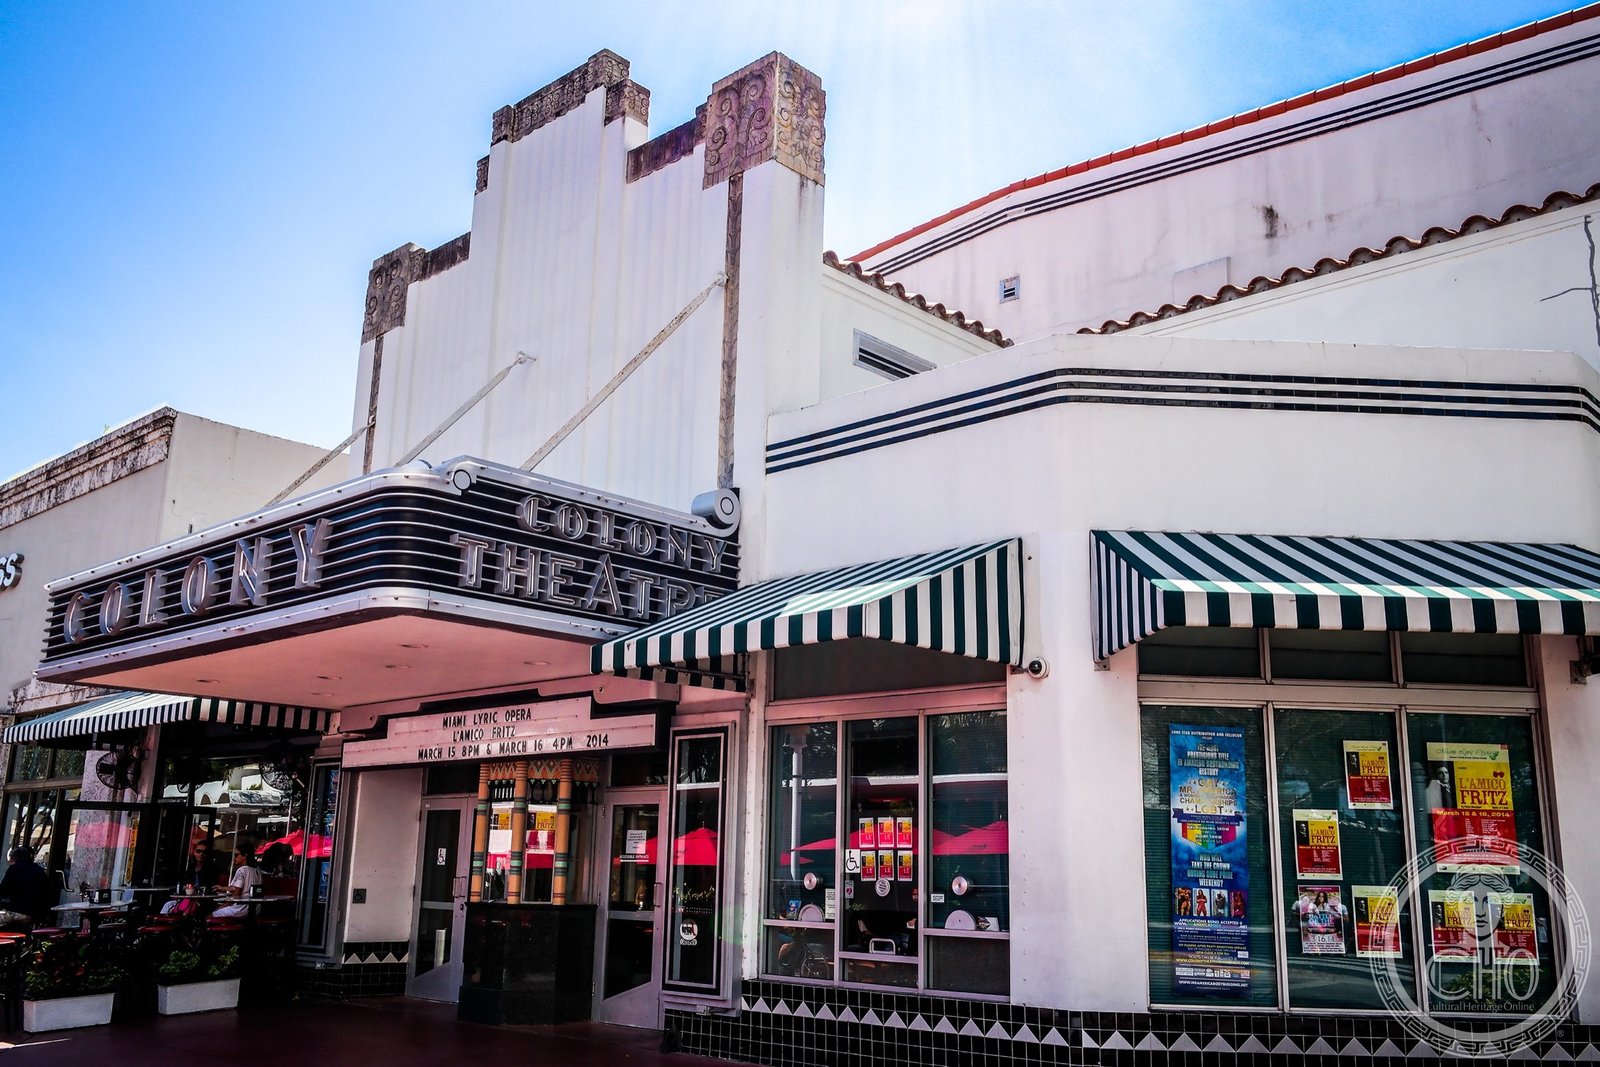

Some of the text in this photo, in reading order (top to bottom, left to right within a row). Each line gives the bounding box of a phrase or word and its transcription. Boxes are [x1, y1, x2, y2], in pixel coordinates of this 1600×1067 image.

[516, 494, 729, 573] COLONY
[64, 518, 333, 645] COLONY
[442, 708, 532, 728] MIAMI LYRIC OPERA
[453, 725, 516, 743] L'AMICO FRITZ
[418, 733, 609, 760] MARCH 15 8PM & MARCH 16 4PM 2014
[1362, 765, 1386, 774] FRITZ
[1197, 778, 1219, 788] GAY
[1459, 777, 1506, 790] L'AMICO
[1460, 789, 1508, 806] FRITZ
[1195, 804, 1224, 814] LGBT
[1311, 835, 1336, 844] FRITZ
[1506, 919, 1531, 928] FRITZ
